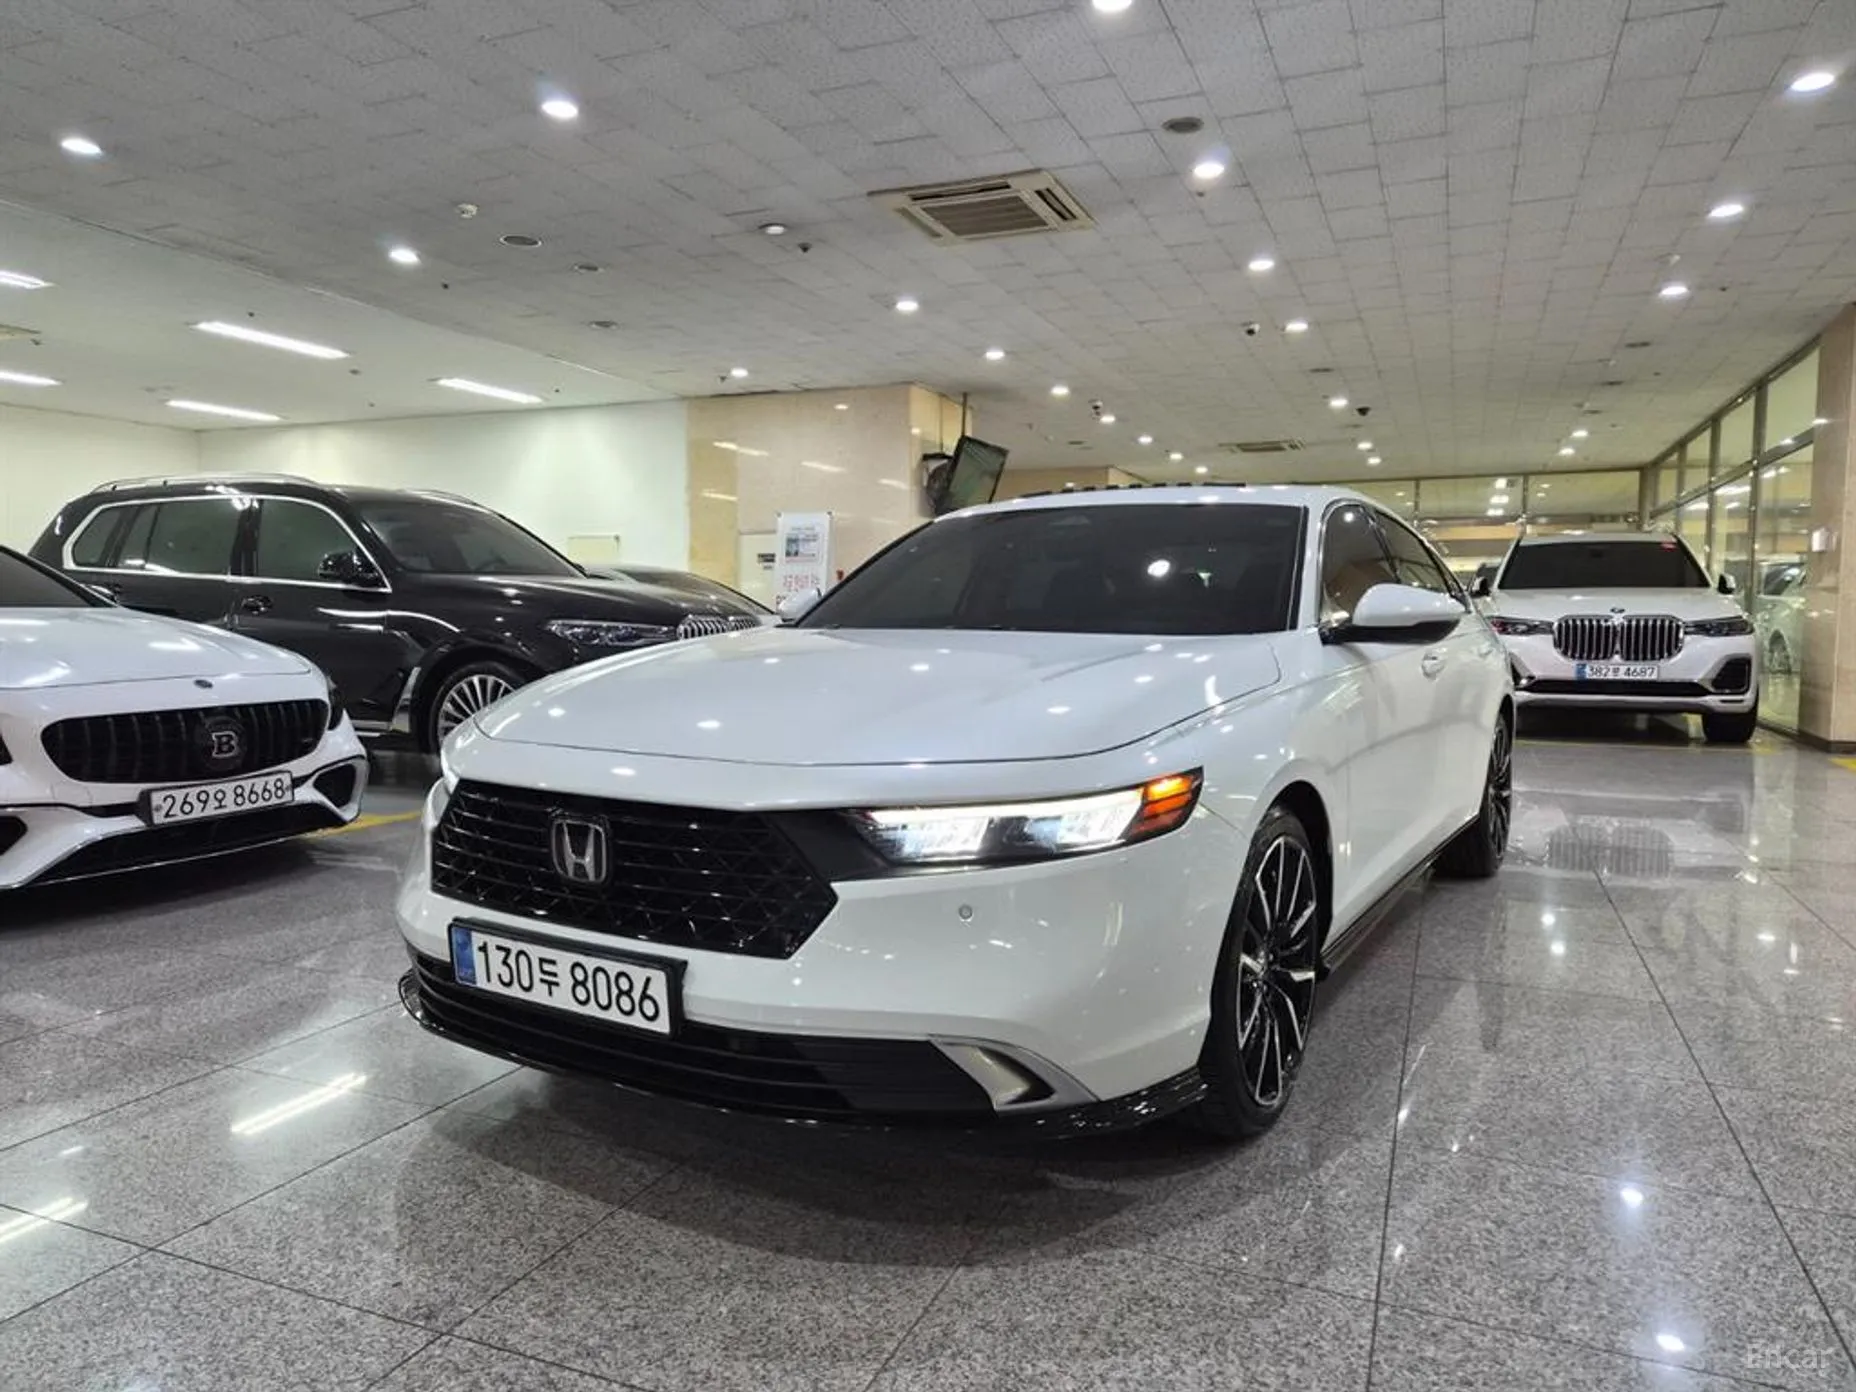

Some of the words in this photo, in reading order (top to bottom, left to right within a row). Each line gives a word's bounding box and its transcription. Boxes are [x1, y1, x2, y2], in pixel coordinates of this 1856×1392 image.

[1623, 667, 1655, 678] 4687
[211, 730, 239, 760] B
[162, 788, 227, 820] 269오
[233, 777, 287, 808] 8668
[478, 941, 560, 997] 130두
[570, 961, 660, 1023] 8086
